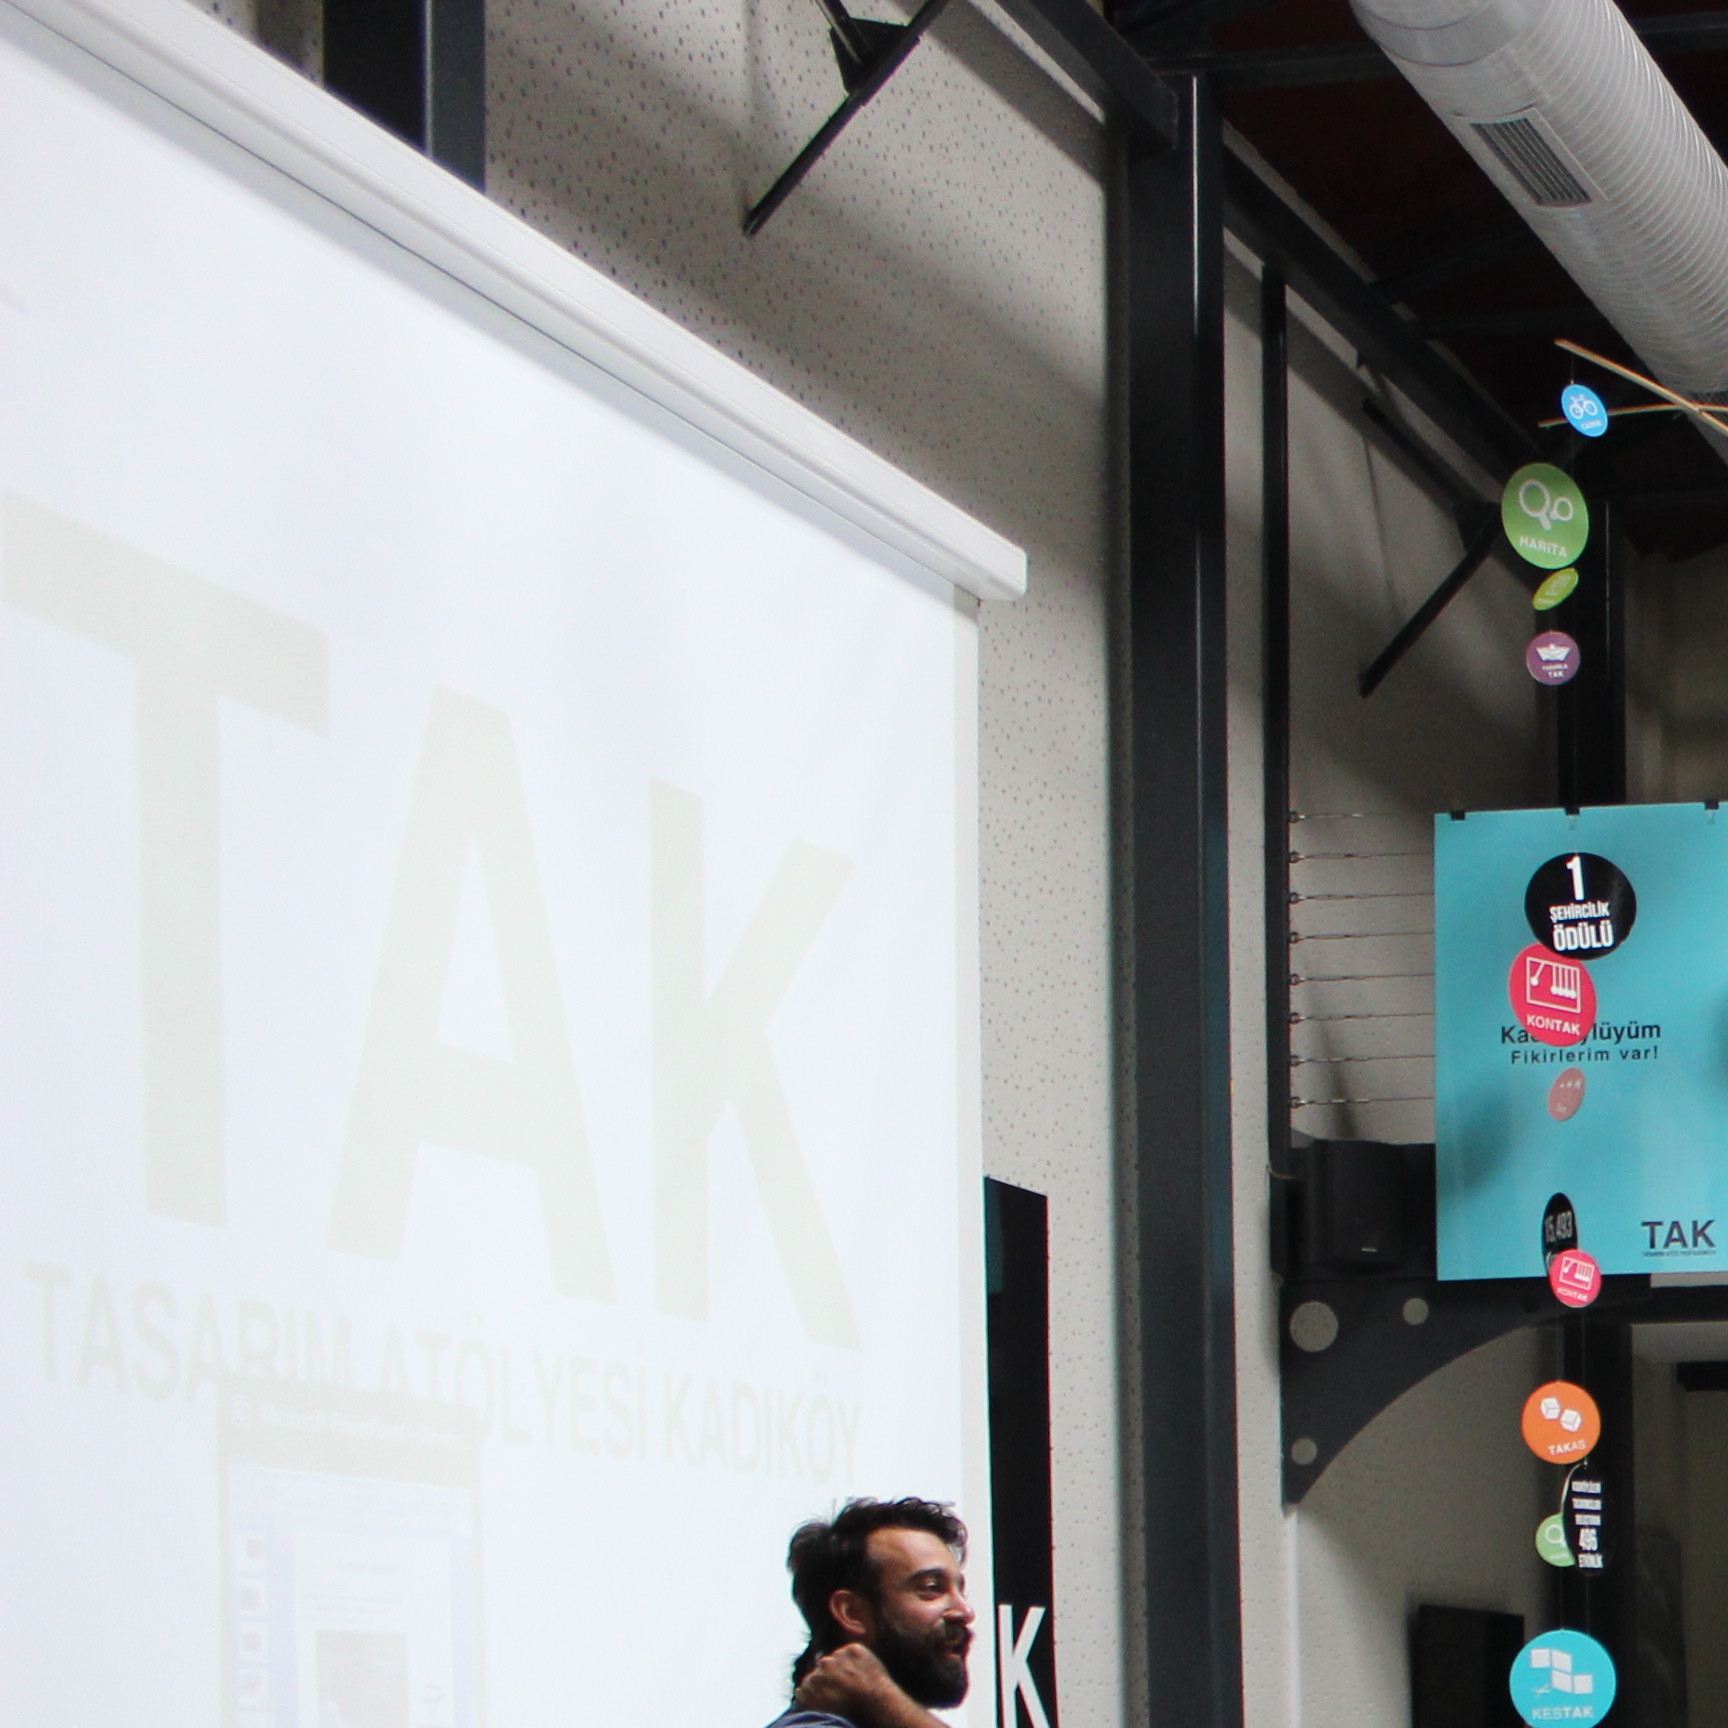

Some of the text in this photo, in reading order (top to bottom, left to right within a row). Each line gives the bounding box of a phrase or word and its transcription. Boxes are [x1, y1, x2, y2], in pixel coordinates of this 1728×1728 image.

[1547, 670, 1565, 678] TAK
[1566, 855, 1585, 901] 1
[0, 492, 862, 1350] TAK
[1549, 900, 1611, 923] ŞEHİRCİLİK
[1553, 921, 1615, 951] ÖDÜLÜ
[1526, 1013, 1581, 1036] KONTAK
[1511, 1046, 1659, 1065] Fikirlerim var!
[1641, 1219, 1717, 1250] TAK
[1557, 1286, 1590, 1302] KONTAK
[24, 1260, 863, 1484] TASARIM ATÖLYESİ KADIKÖY
[1548, 1440, 1587, 1455] TAKAS
[1532, 1705, 1594, 1720] KESTAK
